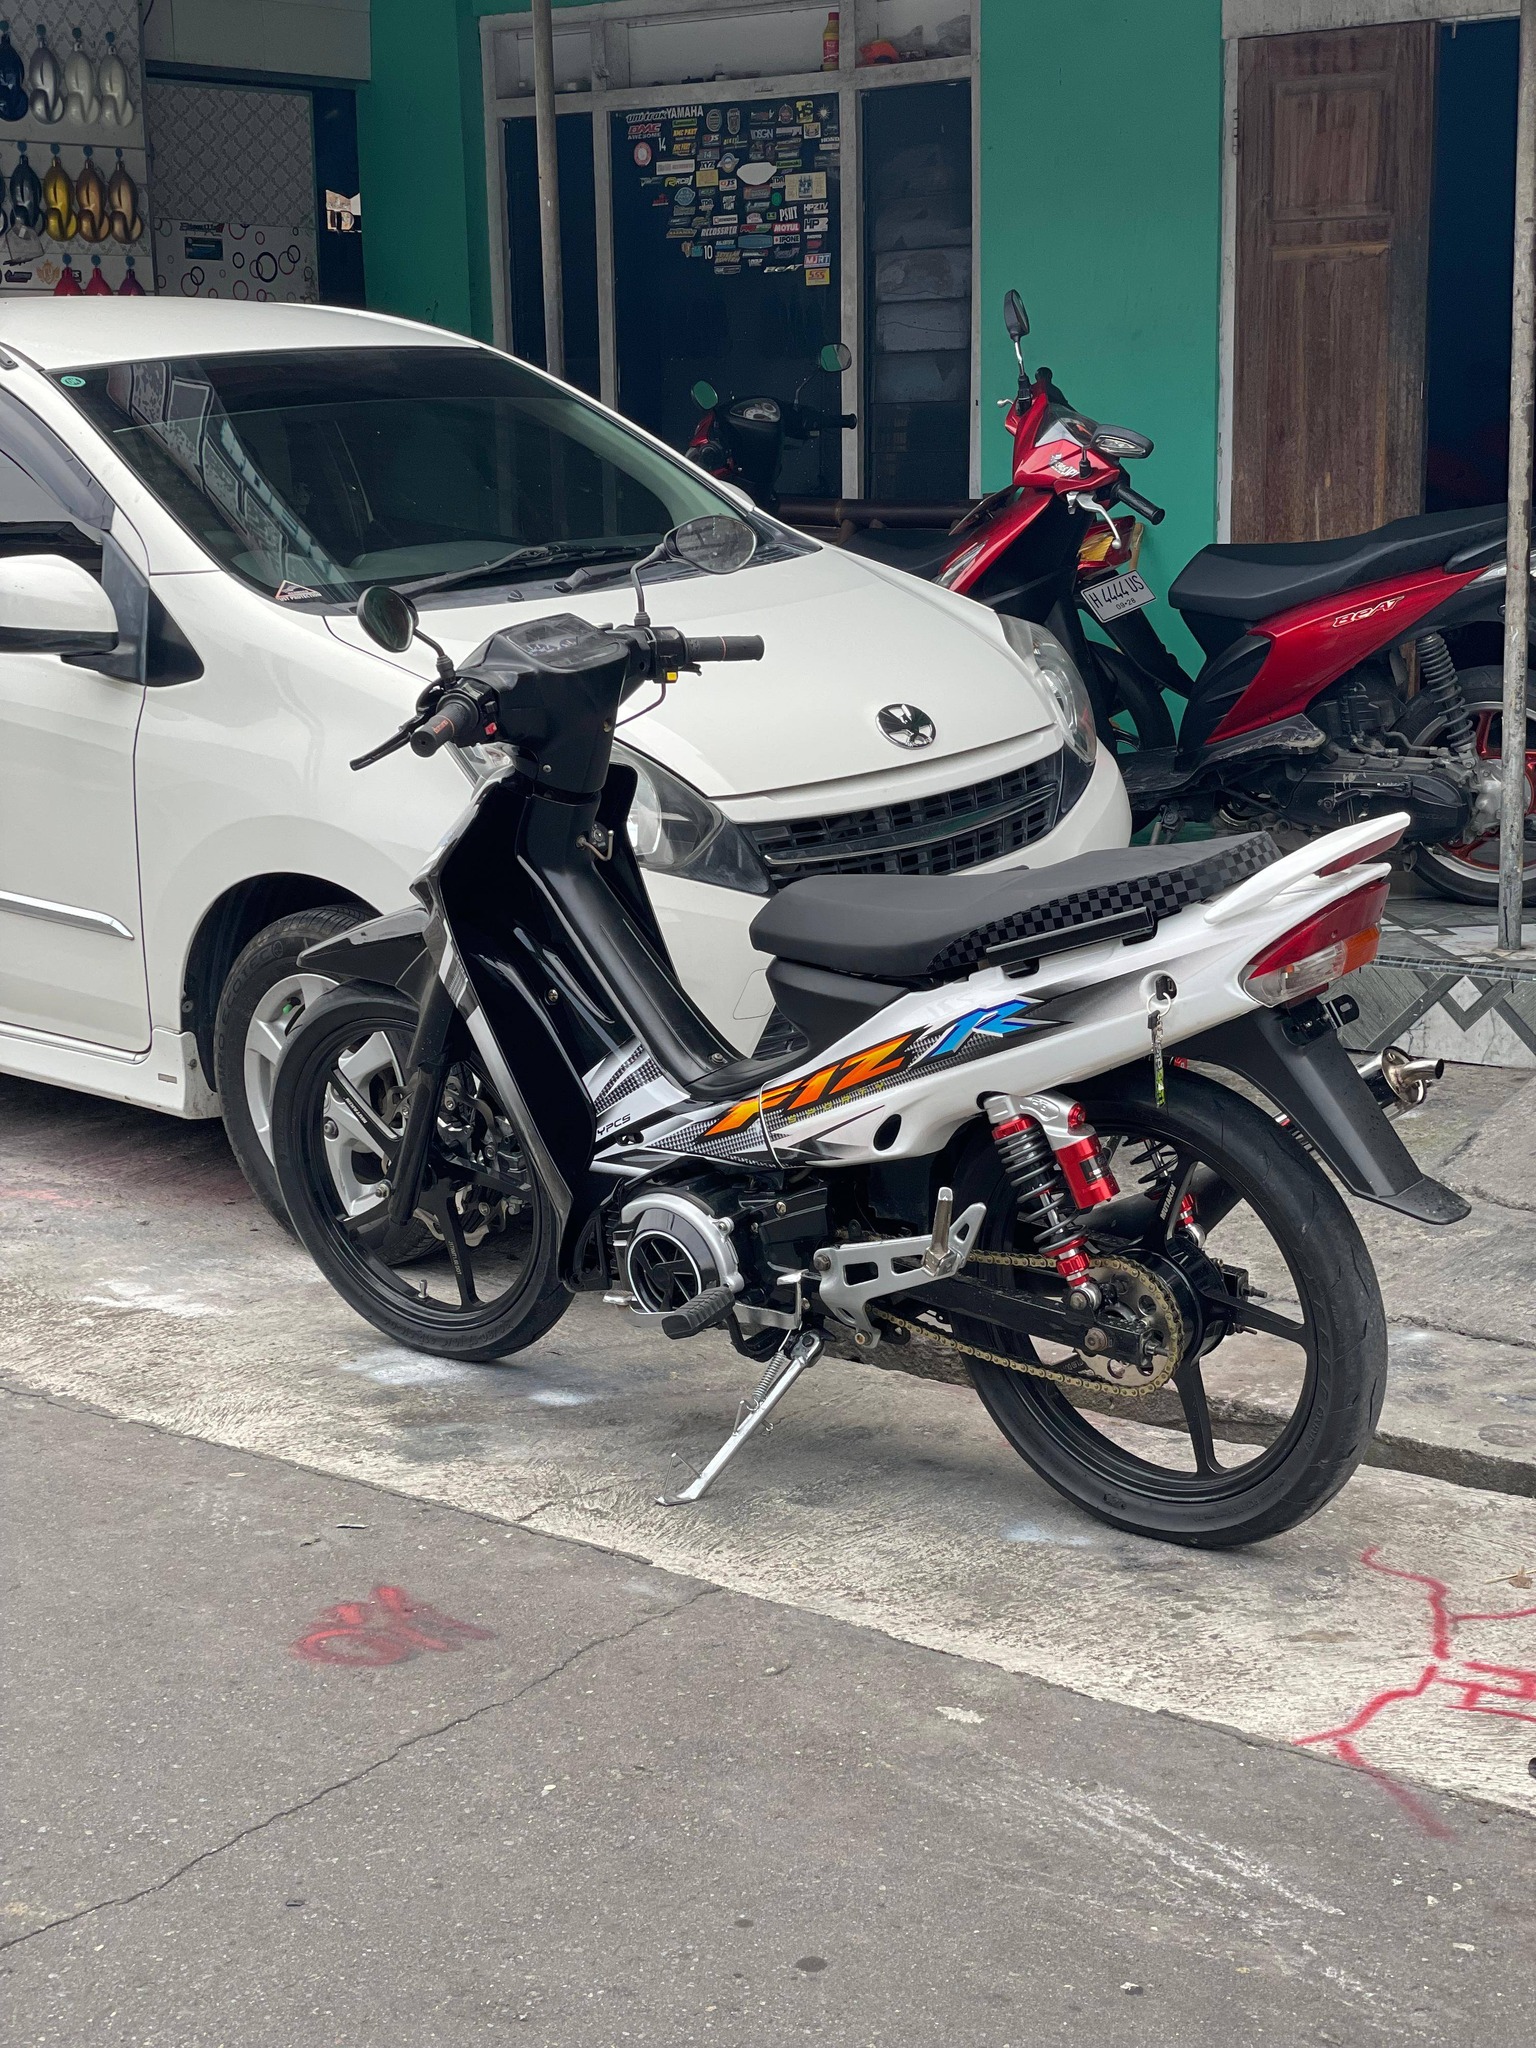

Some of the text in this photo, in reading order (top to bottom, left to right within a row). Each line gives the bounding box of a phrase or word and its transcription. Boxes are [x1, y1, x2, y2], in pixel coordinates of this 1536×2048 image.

[667, 106, 704, 118] YAMAHA
[774, 224, 799, 232] MOTUL
[704, 245, 713, 259] 10
[1089, 575, 1145, 608] H 4444 US
[597, 1113, 631, 1136] YPCS
